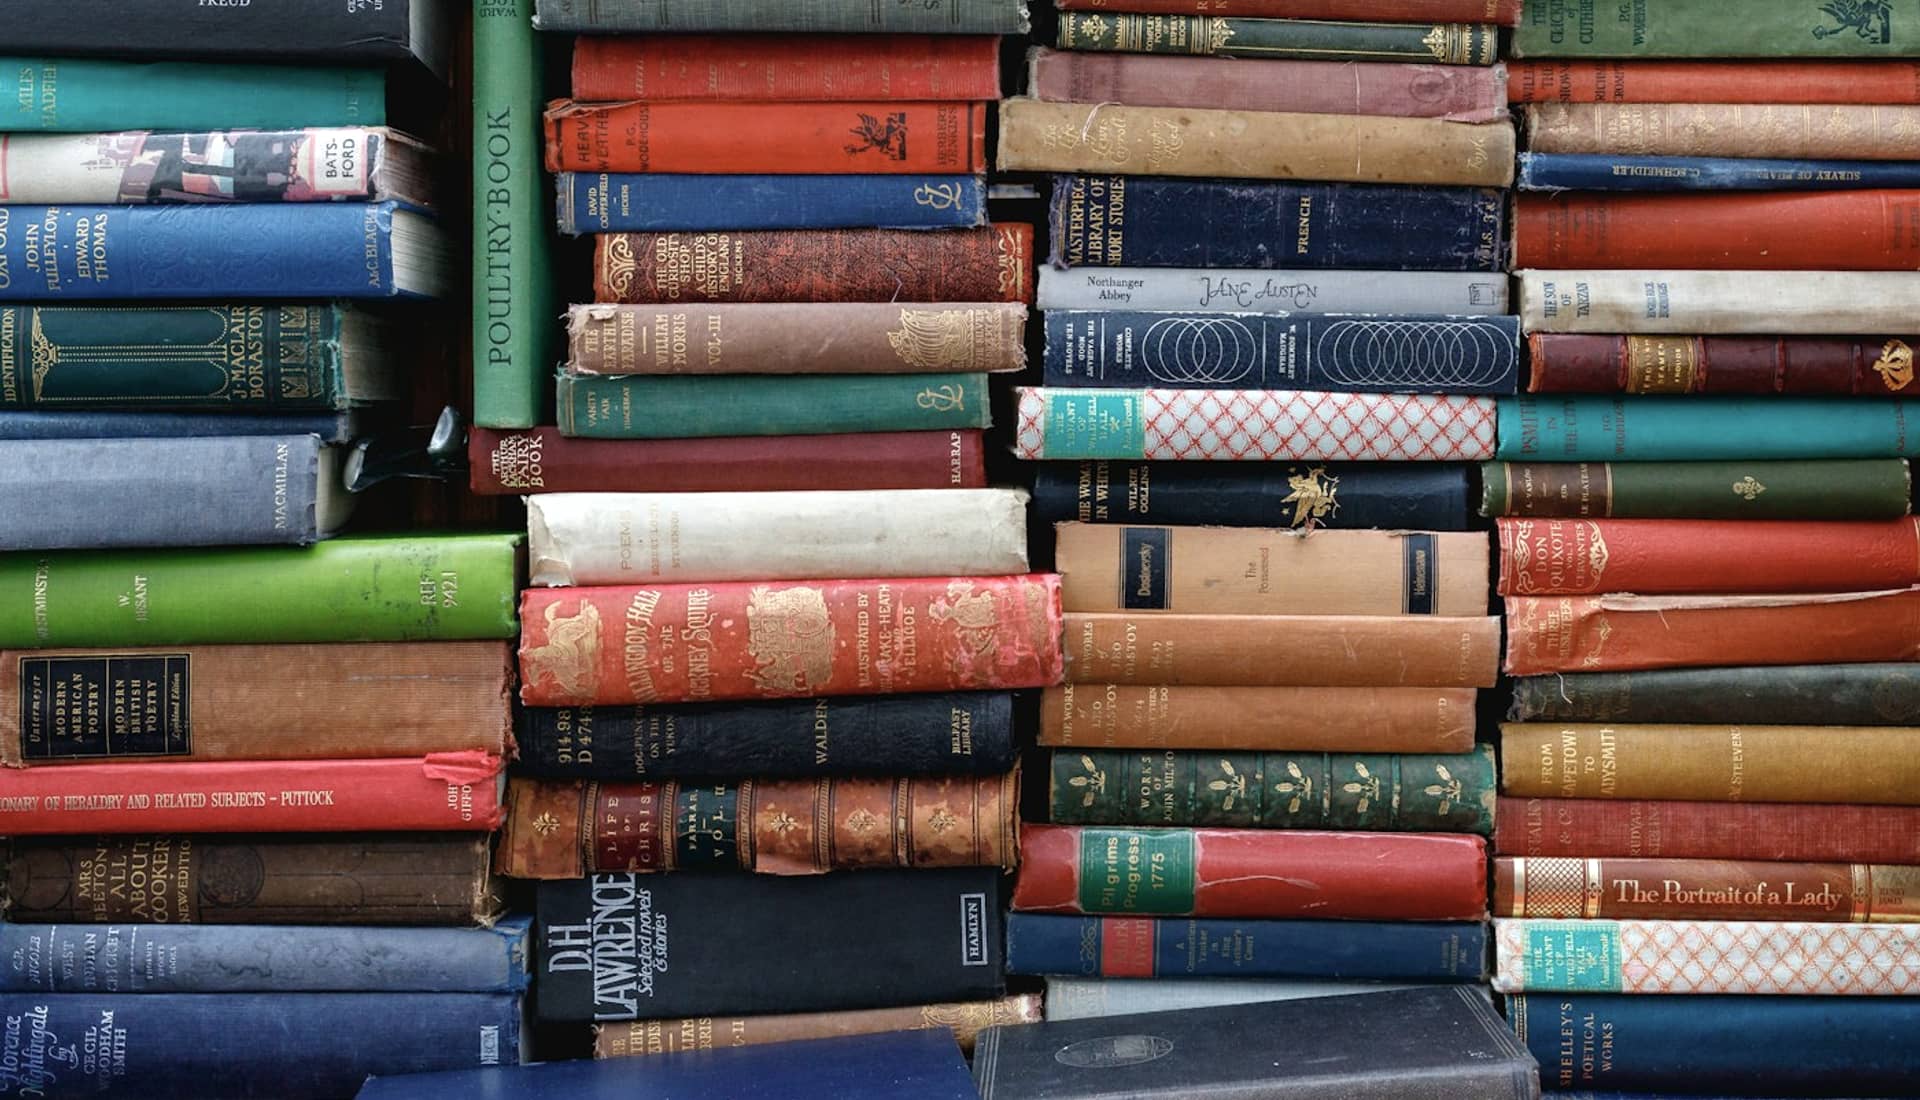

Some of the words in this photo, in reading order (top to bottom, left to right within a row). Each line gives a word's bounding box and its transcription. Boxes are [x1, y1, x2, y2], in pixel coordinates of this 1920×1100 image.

[20, 67, 34, 112] MILES
[326, 138, 337, 178] BATS-
[342, 138, 355, 178] FORD
[589, 187, 597, 216] DAVID
[1297, 195, 1312, 255] FRENCH
[26, 223, 39, 272] JOHN
[76, 217, 91, 279] EDWARD
[93, 213, 109, 282] THOMAS
[656, 237, 668, 262] OLD
[1088, 198, 1105, 264] LIBRARY
[658, 263, 668, 289] THE
[680, 246, 691, 283] SHOP
[707, 248, 718, 299] HISTORY
[719, 234, 730, 292] ENGLAND
[735, 240, 744, 284] DICKENS
[1087, 275, 1145, 290] Northanger
[696, 282, 706, 294] A
[1098, 289, 1132, 303] Abbey
[1544, 299, 1557, 319] THE
[1561, 293, 1571, 306] OF
[1576, 282, 1589, 318] TARZAN
[2, 308, 17, 402] IDENTIFICATION
[249, 306, 265, 399] BORASTON
[585, 328, 599, 354] THE
[621, 311, 635, 369] PARADISE
[655, 313, 669, 367] WILLIAM
[673, 312, 687, 366] MORRIS
[1066, 322, 1074, 343] TEN
[1116, 333, 1124, 364] WORKS
[1124, 327, 1132, 370] COMPLETE
[491, 449, 501, 475] THE
[500, 439, 509, 487] ARTHUR
[517, 434, 530, 489] FAIRY
[530, 435, 544, 487] BOOK
[951, 432, 961, 483] HARRAP
[275, 443, 289, 530] MACMILLAN
[1129, 468, 1139, 511] WILKIE
[1140, 465, 1149, 513] COLLINS
[1096, 507, 1108, 520] IN
[1245, 561, 1257, 580] The
[1536, 536, 1548, 572] DON
[1551, 520, 1564, 588] QUIXOTE
[1575, 523, 1588, 587] CERVANTES
[857, 592, 869, 607] BY
[857, 611, 869, 687] ILLUSTRATED
[1548, 610, 1560, 649] THREE
[56, 681, 66, 736] MODERN
[72, 673, 83, 743] AMERICAN
[88, 682, 99, 734] POETRY
[115, 679, 125, 735] MODERN
[131, 679, 141, 734] BRITISH
[147, 680, 157, 732] POETRY
[557, 709, 571, 763] 914.98
[815, 698, 829, 766] WALDEN
[952, 707, 962, 755] BELFAST
[962, 709, 972, 756] LIBRARY
[577, 751, 593, 764] D
[1541, 743, 1554, 785] FROM
[1584, 756, 1595, 774] TO
[44, 797, 59, 811] OF
[64, 795, 125, 811] HERALDRY
[127, 794, 150, 809] AND
[154, 793, 206, 808] RELATED
[211, 792, 266, 807] SUBJECTS
[280, 790, 334, 806] PUTTOCK
[1141, 756, 1152, 810] WORKS
[607, 797, 619, 853] LIFE
[639, 782, 652, 863] CHRIST
[79, 860, 93, 897] MRS
[110, 855, 127, 899] ALL
[130, 841, 150, 918] ABOUT
[1102, 837, 1120, 907] Pilgrims
[1124, 836, 1142, 908] Progress
[1152, 852, 1165, 889] 1775
[636, 888, 652, 935] novels
[1613, 880, 1659, 902] The
[1663, 880, 1741, 904] Portrait
[1744, 881, 1768, 905] of
[1767, 892, 1780, 906] a
[1785, 882, 1843, 911] Lady
[548, 917, 592, 973] D.H.
[592, 873, 639, 1021] LAWRENCE
[652, 912, 668, 958] stories
[968, 901, 979, 957] HAMLYN
[62, 939, 75, 981] WEST
[84, 932, 97, 987] INDIAN
[106, 926, 120, 992] CRICKET
[637, 935, 653, 997] Selected
[653, 958, 668, 973] &
[1533, 947, 1542, 969] THE
[1544, 935, 1553, 981] TENANT
[1556, 951, 1564, 967] OF
[1565, 931, 1575, 985] WILDFELL
[1576, 946, 1586, 976] HALL
[20, 1005, 57, 1097] Nightingale
[84, 1025, 97, 1074] CECIL
[113, 1028, 127, 1076] SMITH
[1561, 1002, 1574, 1088] SHELLEY'S
[1582, 1012, 1595, 1080] POETICAL
[1602, 1022, 1615, 1072] WORKS
